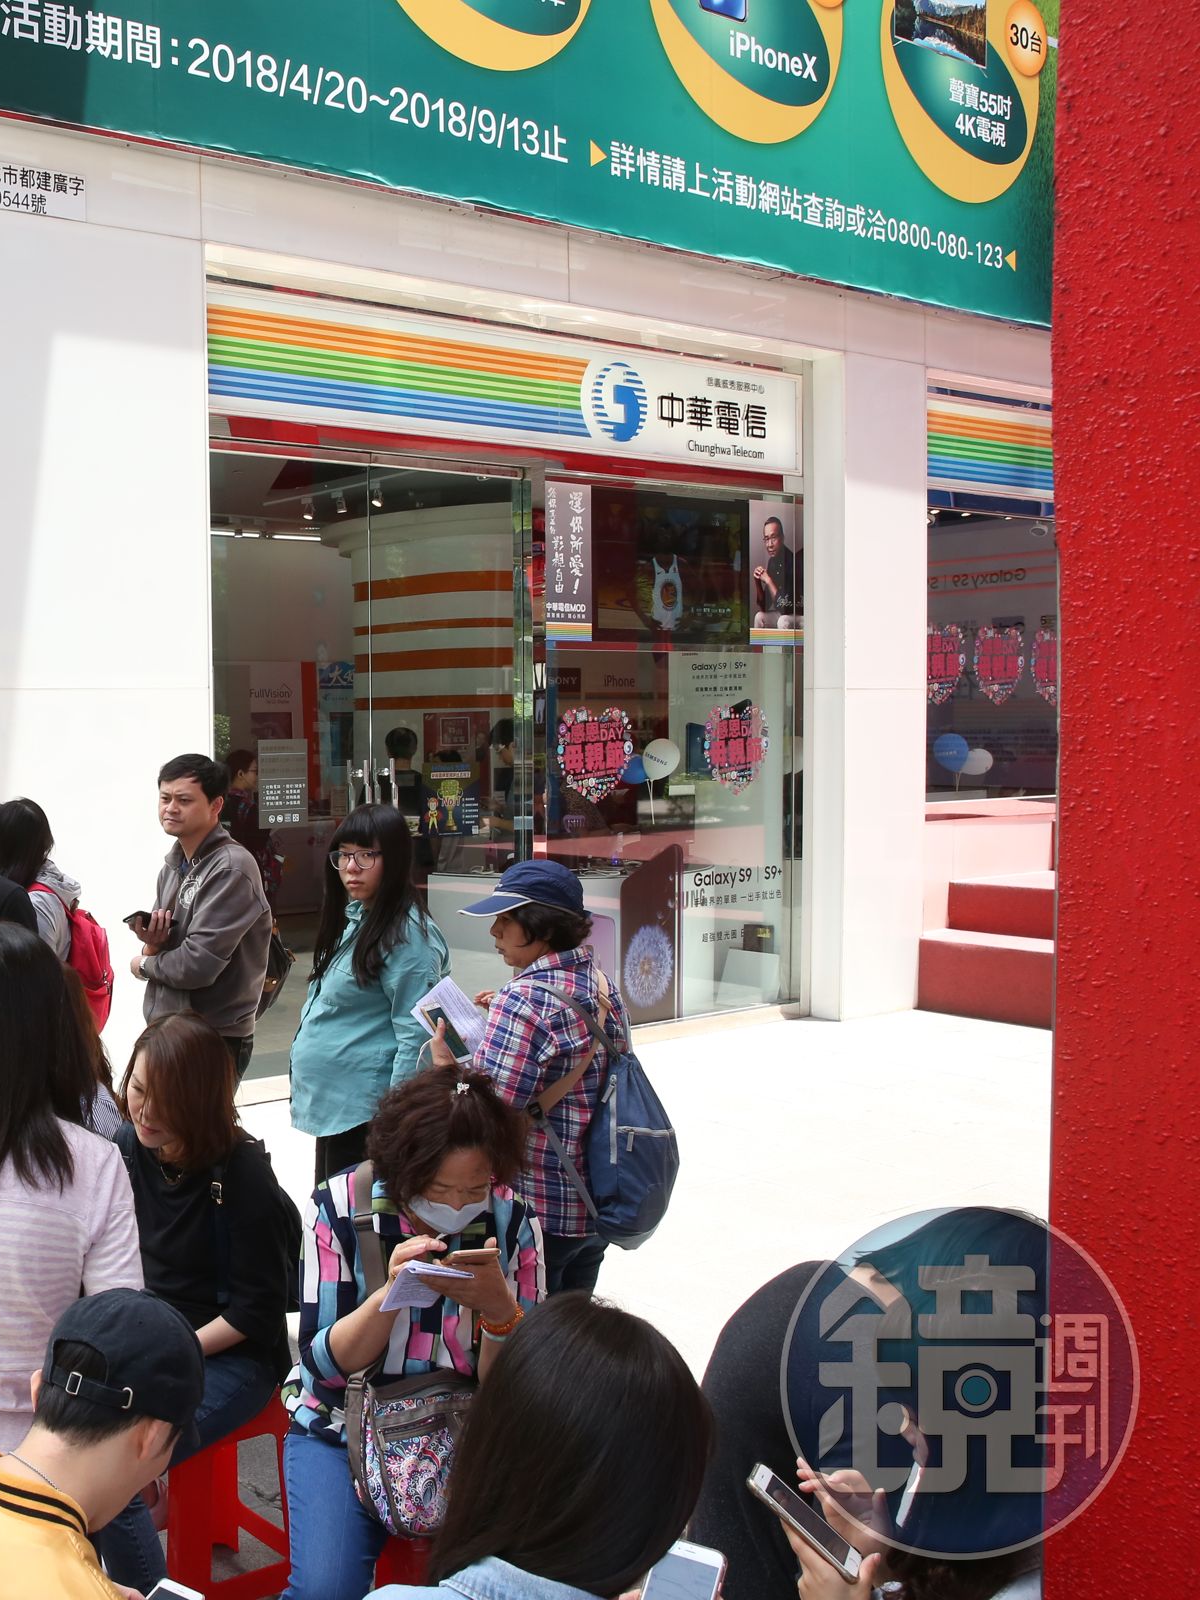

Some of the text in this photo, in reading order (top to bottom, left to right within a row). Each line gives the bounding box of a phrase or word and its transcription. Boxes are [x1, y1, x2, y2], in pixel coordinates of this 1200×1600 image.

[1009, 23, 1043, 56] 30台
[729, 30, 818, 83] iPhoneX
[948, 77, 1013, 121] 聲寶55吋
[955, 114, 1007, 148] 4K電視
[657, 392, 768, 439] 中華電信
[688, 440, 765, 460] Chunghwa Telecom
[691, 661, 747, 672] Galaxy S9 S9+
[547, 676, 578, 685] SONY
[604, 674, 636, 688] iPhone
[249, 688, 291, 699] FullVision
[600, 727, 624, 741] DAY
[693, 865, 782, 888] Galaxy S9 S9+
